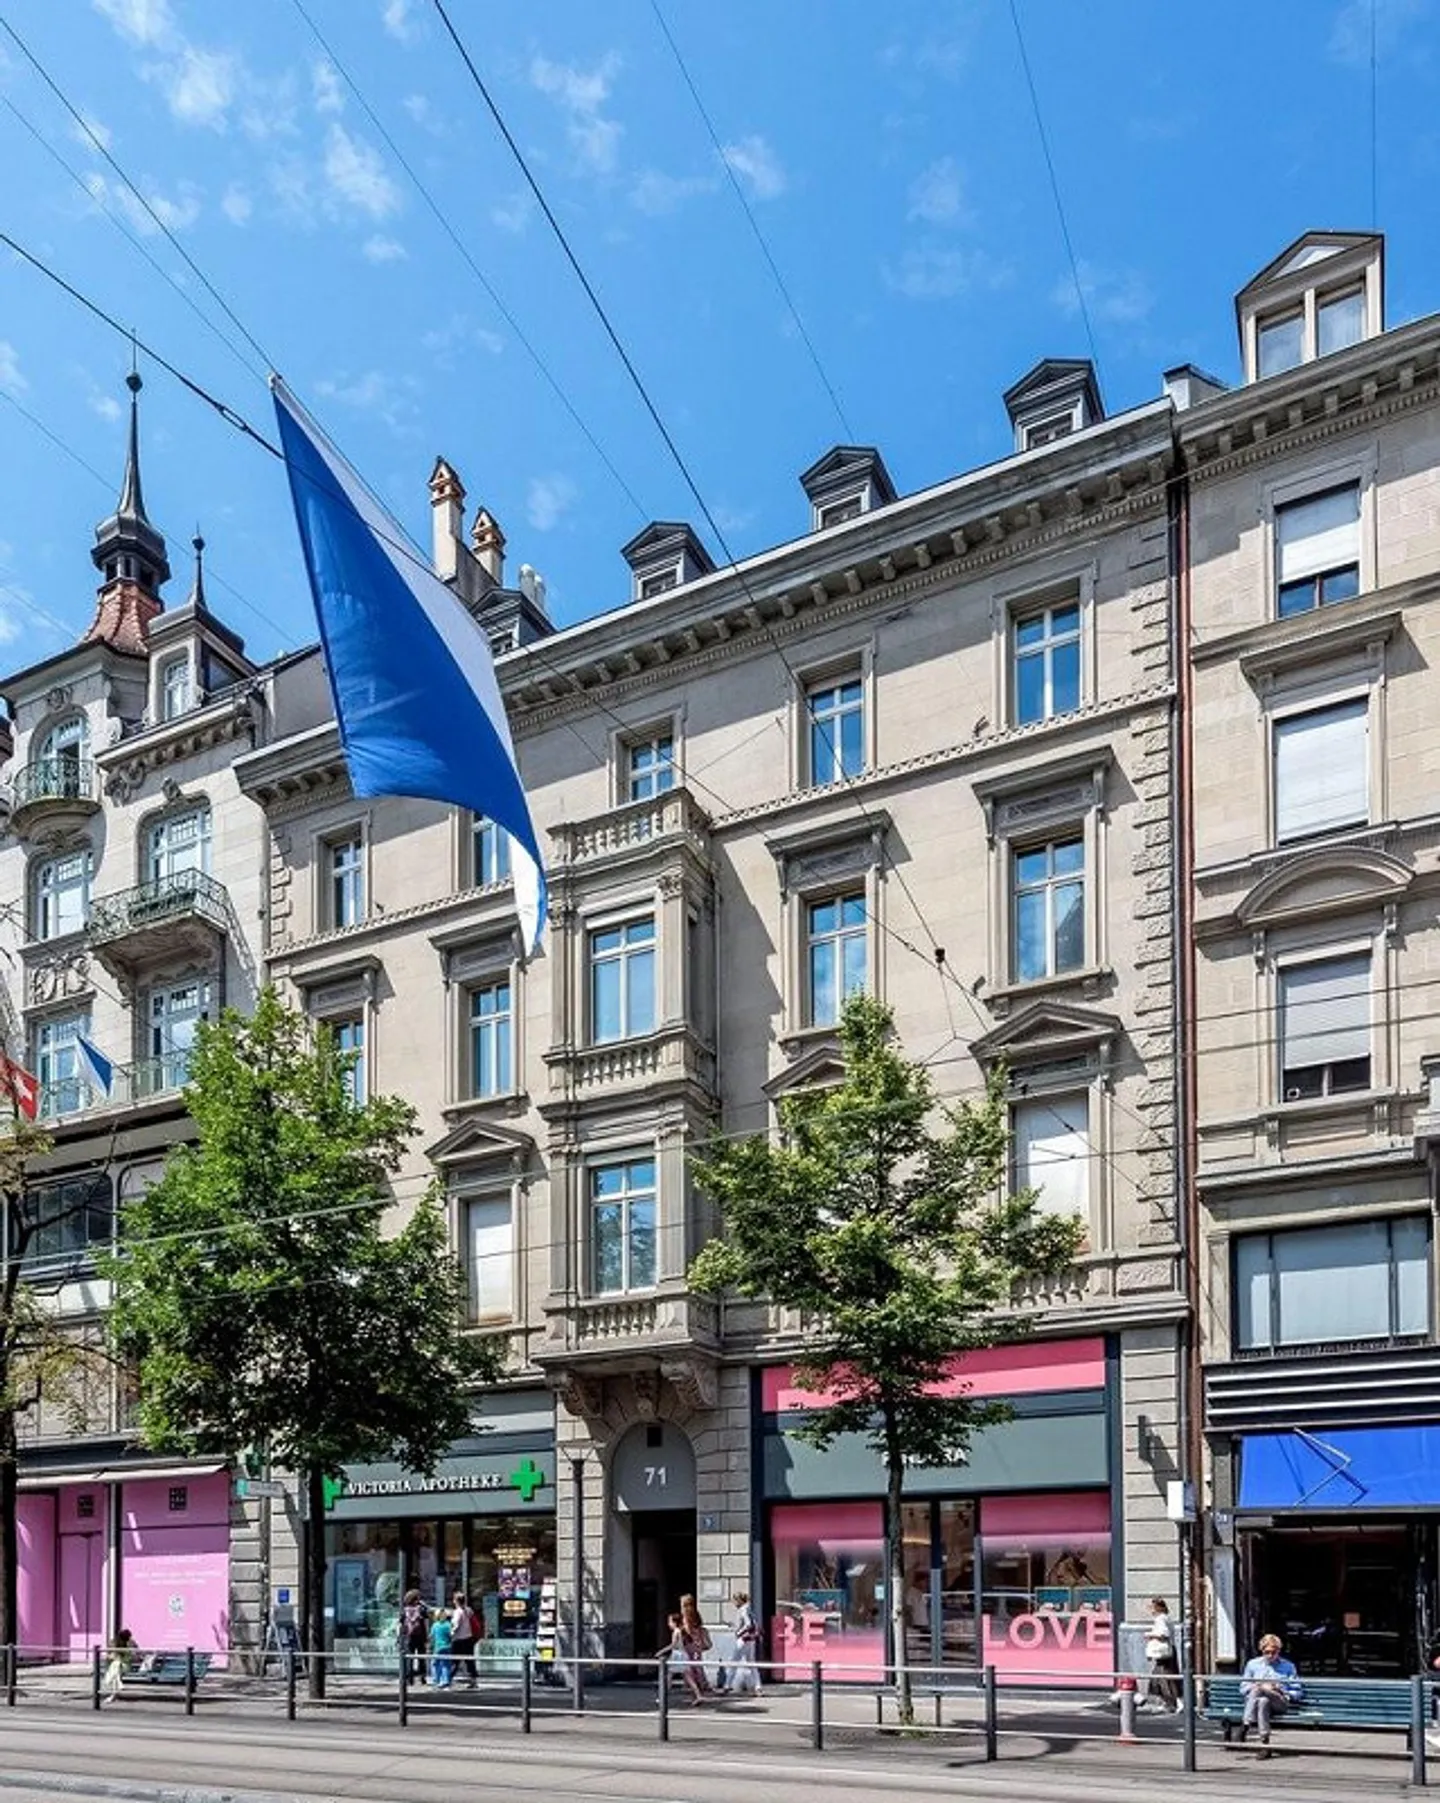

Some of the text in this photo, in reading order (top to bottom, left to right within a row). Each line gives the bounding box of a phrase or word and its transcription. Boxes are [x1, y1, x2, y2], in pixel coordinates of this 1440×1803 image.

[349, 1474, 501, 1494] VICTORIA APOTHEKE
[644, 1466, 667, 1486] 71
[776, 1614, 826, 1647] BE
[983, 1612, 1112, 1648] LOVE
